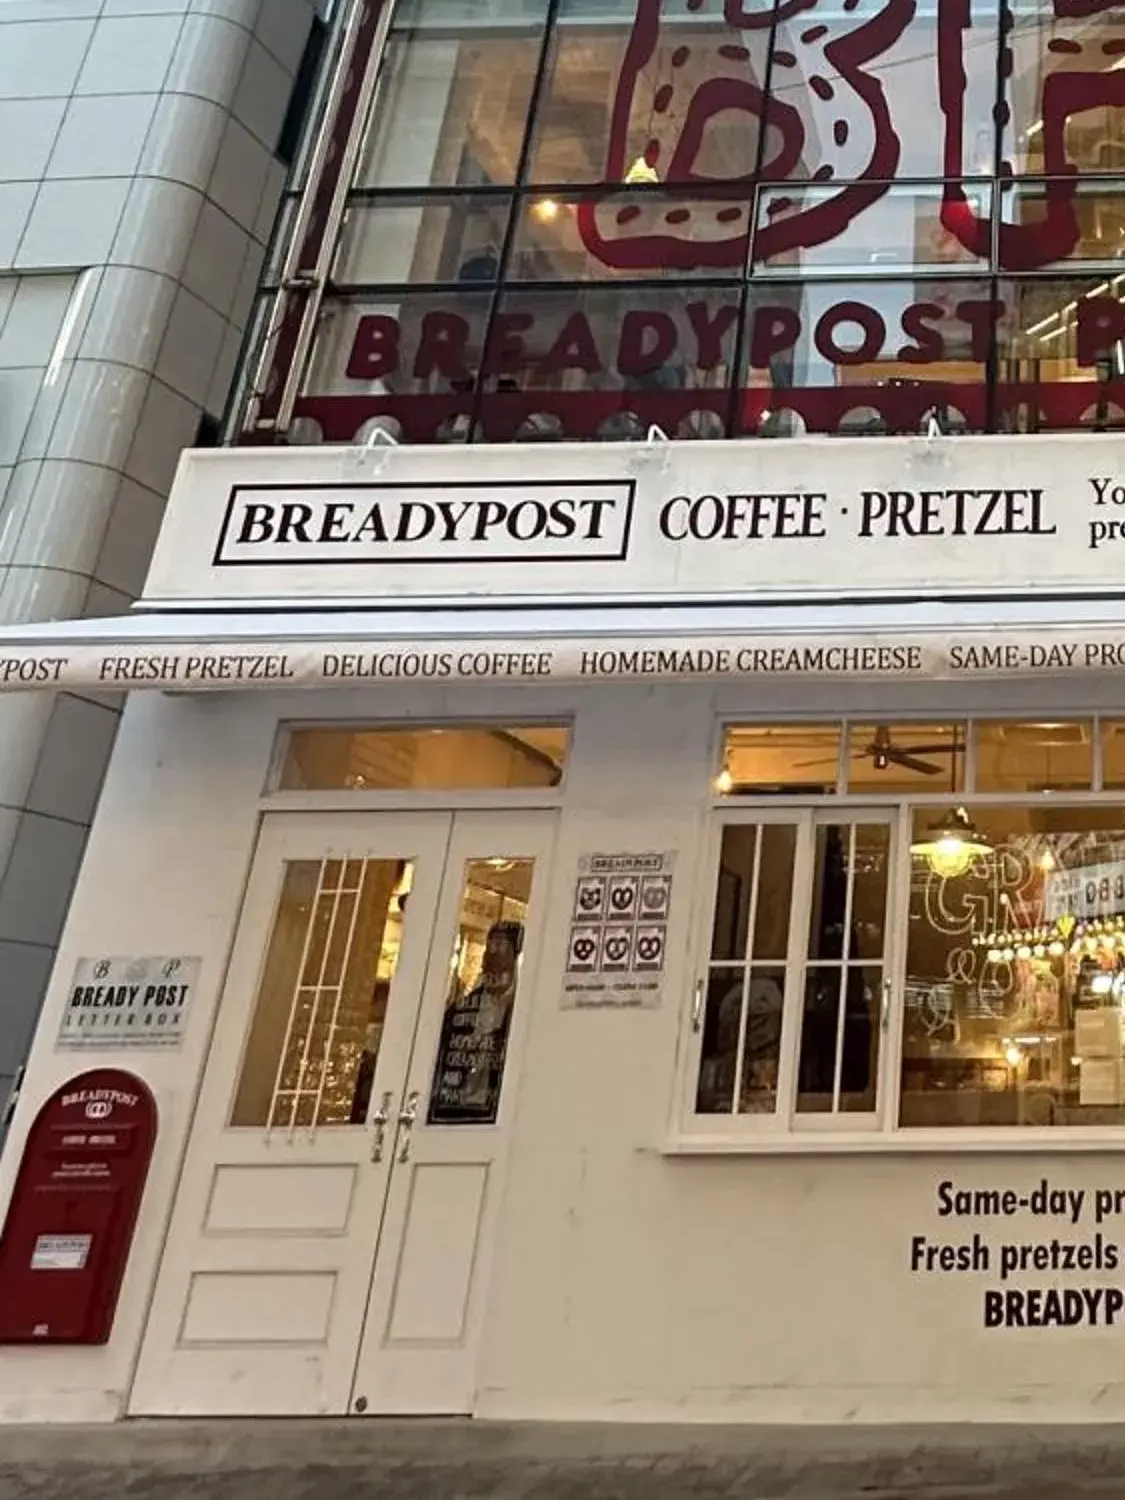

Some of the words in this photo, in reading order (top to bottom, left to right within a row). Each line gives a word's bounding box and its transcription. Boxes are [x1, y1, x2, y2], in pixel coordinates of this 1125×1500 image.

[345, 298, 1006, 382] BREADYPOST
[236, 498, 616, 545] BREADYPOST
[659, 494, 828, 541] COFFEE
[857, 488, 1057, 538] PRETZEL
[98, 655, 181, 681] FRESH
[183, 654, 295, 680] PRETZEL
[320, 652, 454, 678] DELICIOUS
[456, 650, 554, 677] COFFEE
[579, 648, 731, 676] HOMEMADE
[735, 644, 922, 673] CREAMCHEESE
[948, 642, 1079, 670] SAME-DAY
[71, 985, 140, 1007] BREADY
[143, 984, 189, 1007] POST
[938, 1179, 1085, 1224] Same-day
[911, 1234, 990, 1271] Fresh
[1000, 1233, 1119, 1280] pretzels
